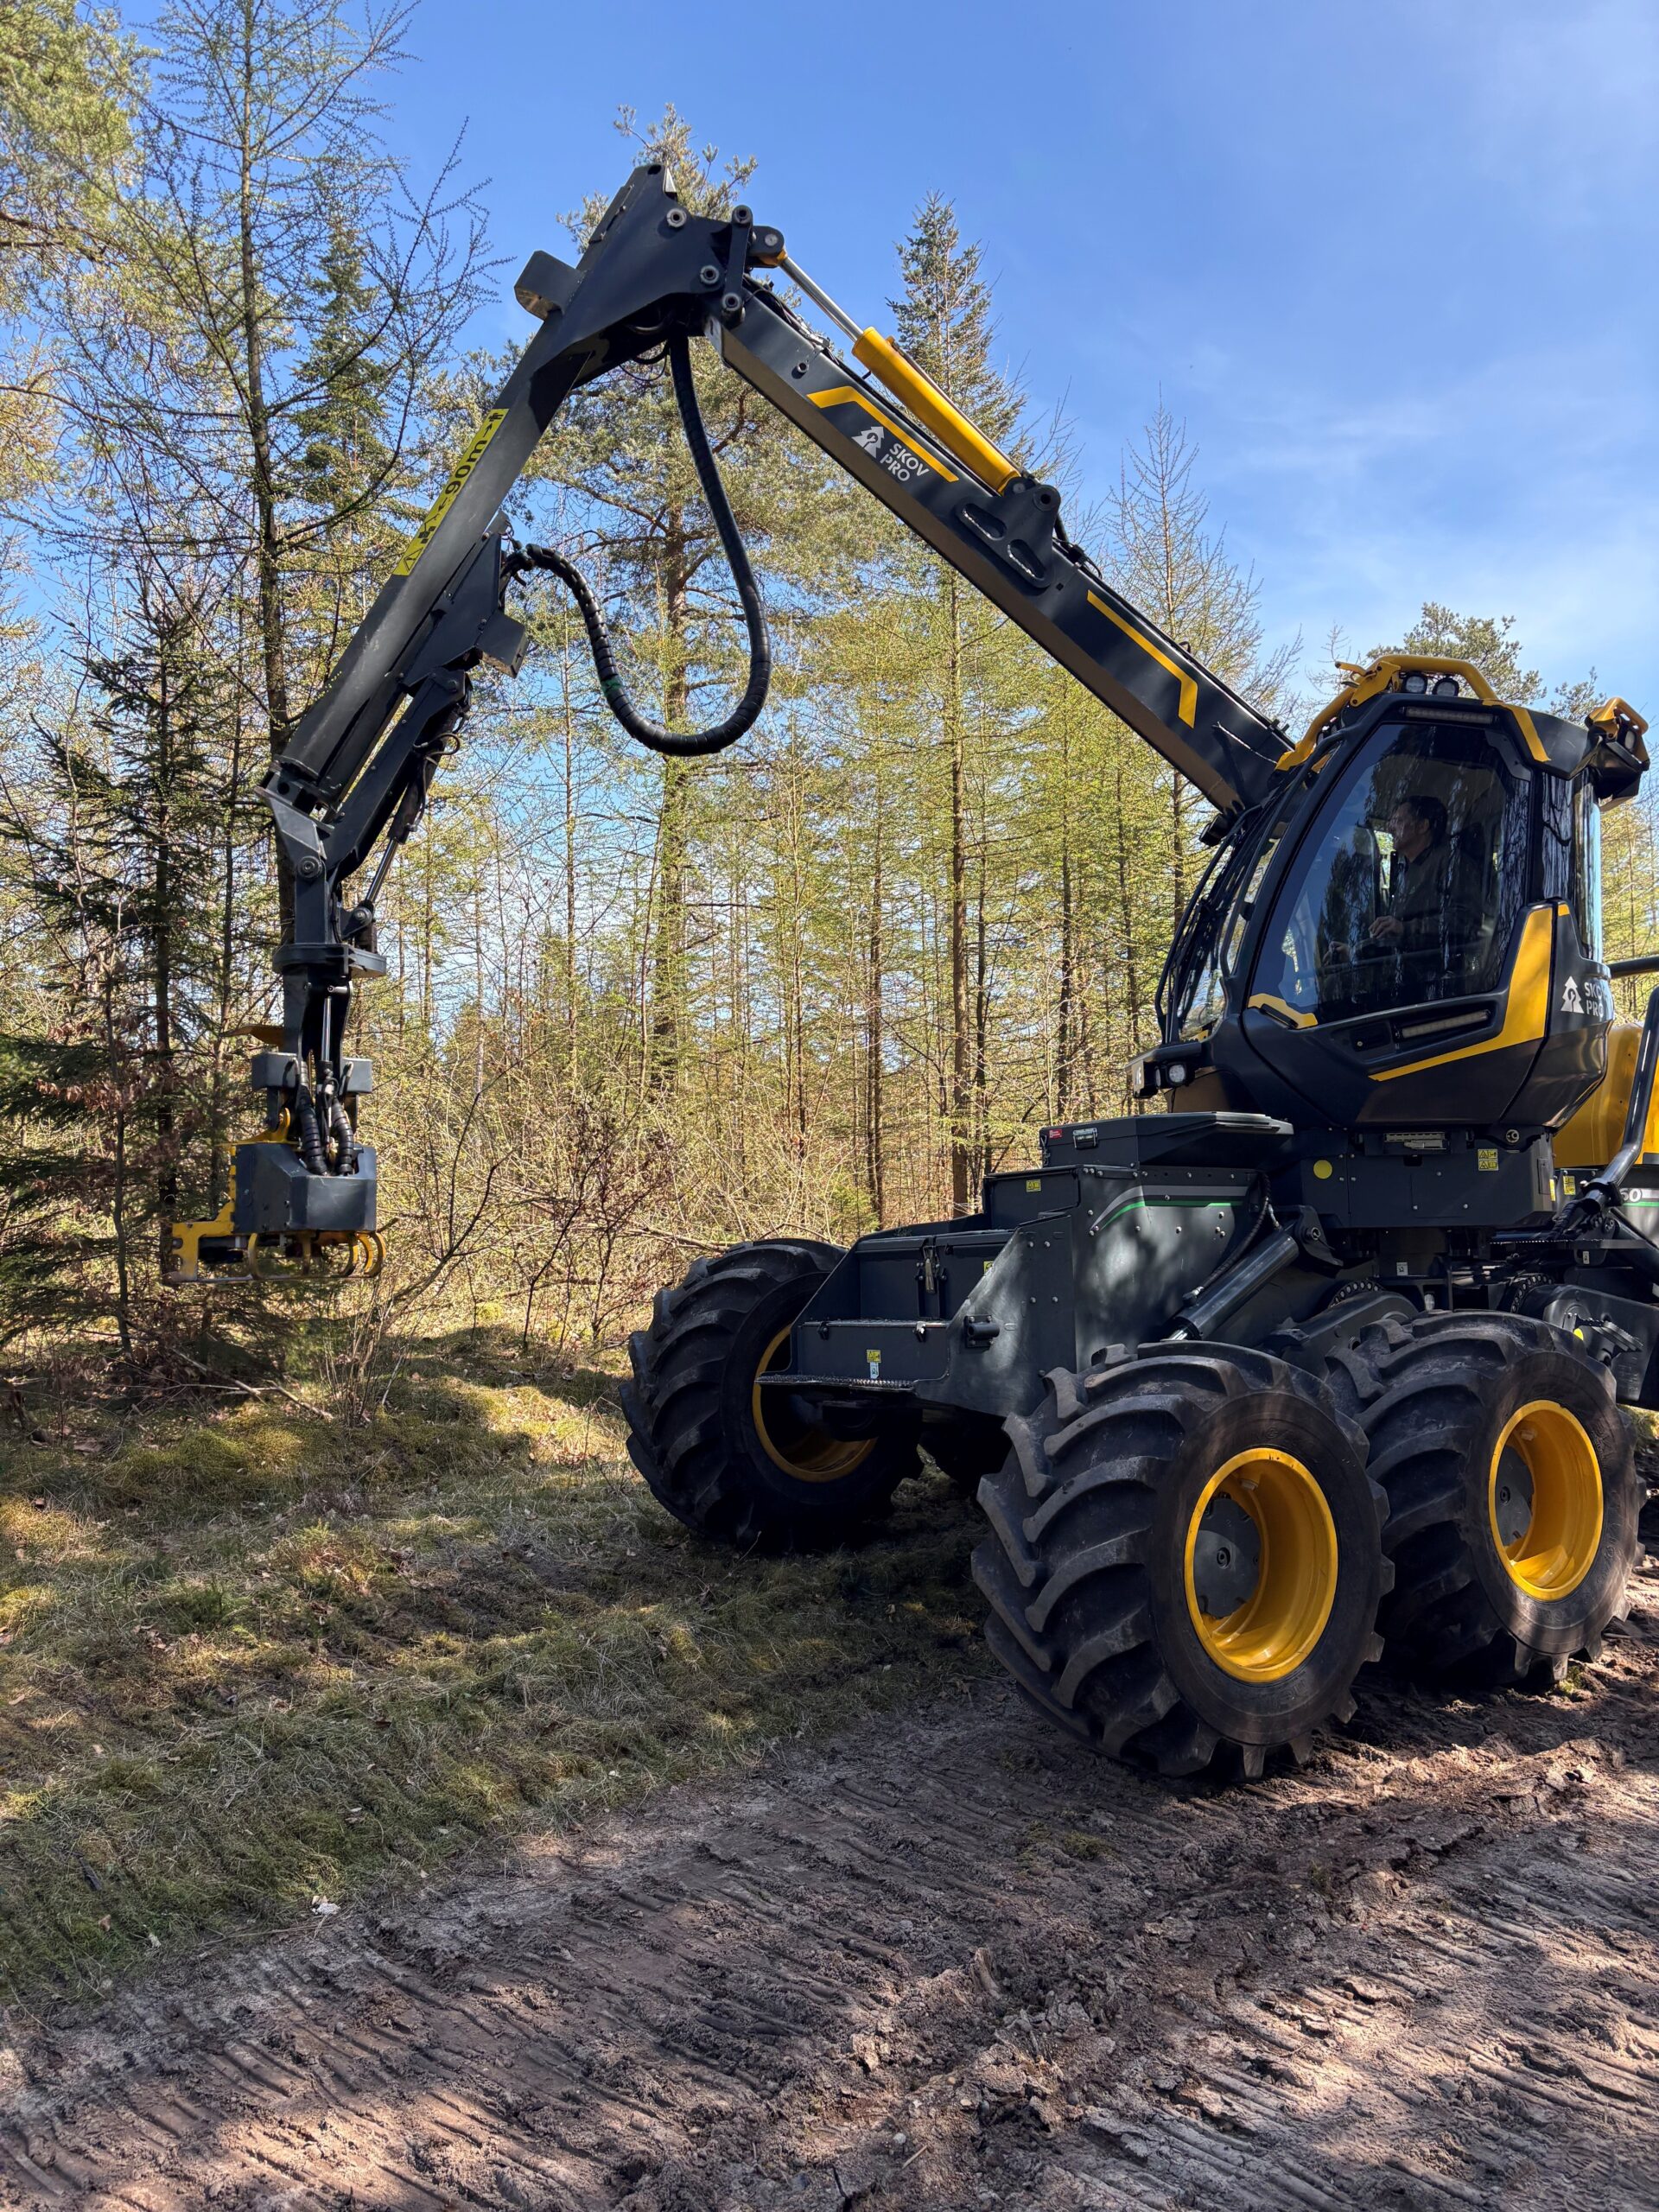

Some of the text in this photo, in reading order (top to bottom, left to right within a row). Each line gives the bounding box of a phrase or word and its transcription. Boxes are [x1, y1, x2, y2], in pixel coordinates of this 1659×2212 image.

[444, 439, 488, 494] 90m
[880, 453, 911, 481] PRO
[889, 442, 931, 477] SKOV
